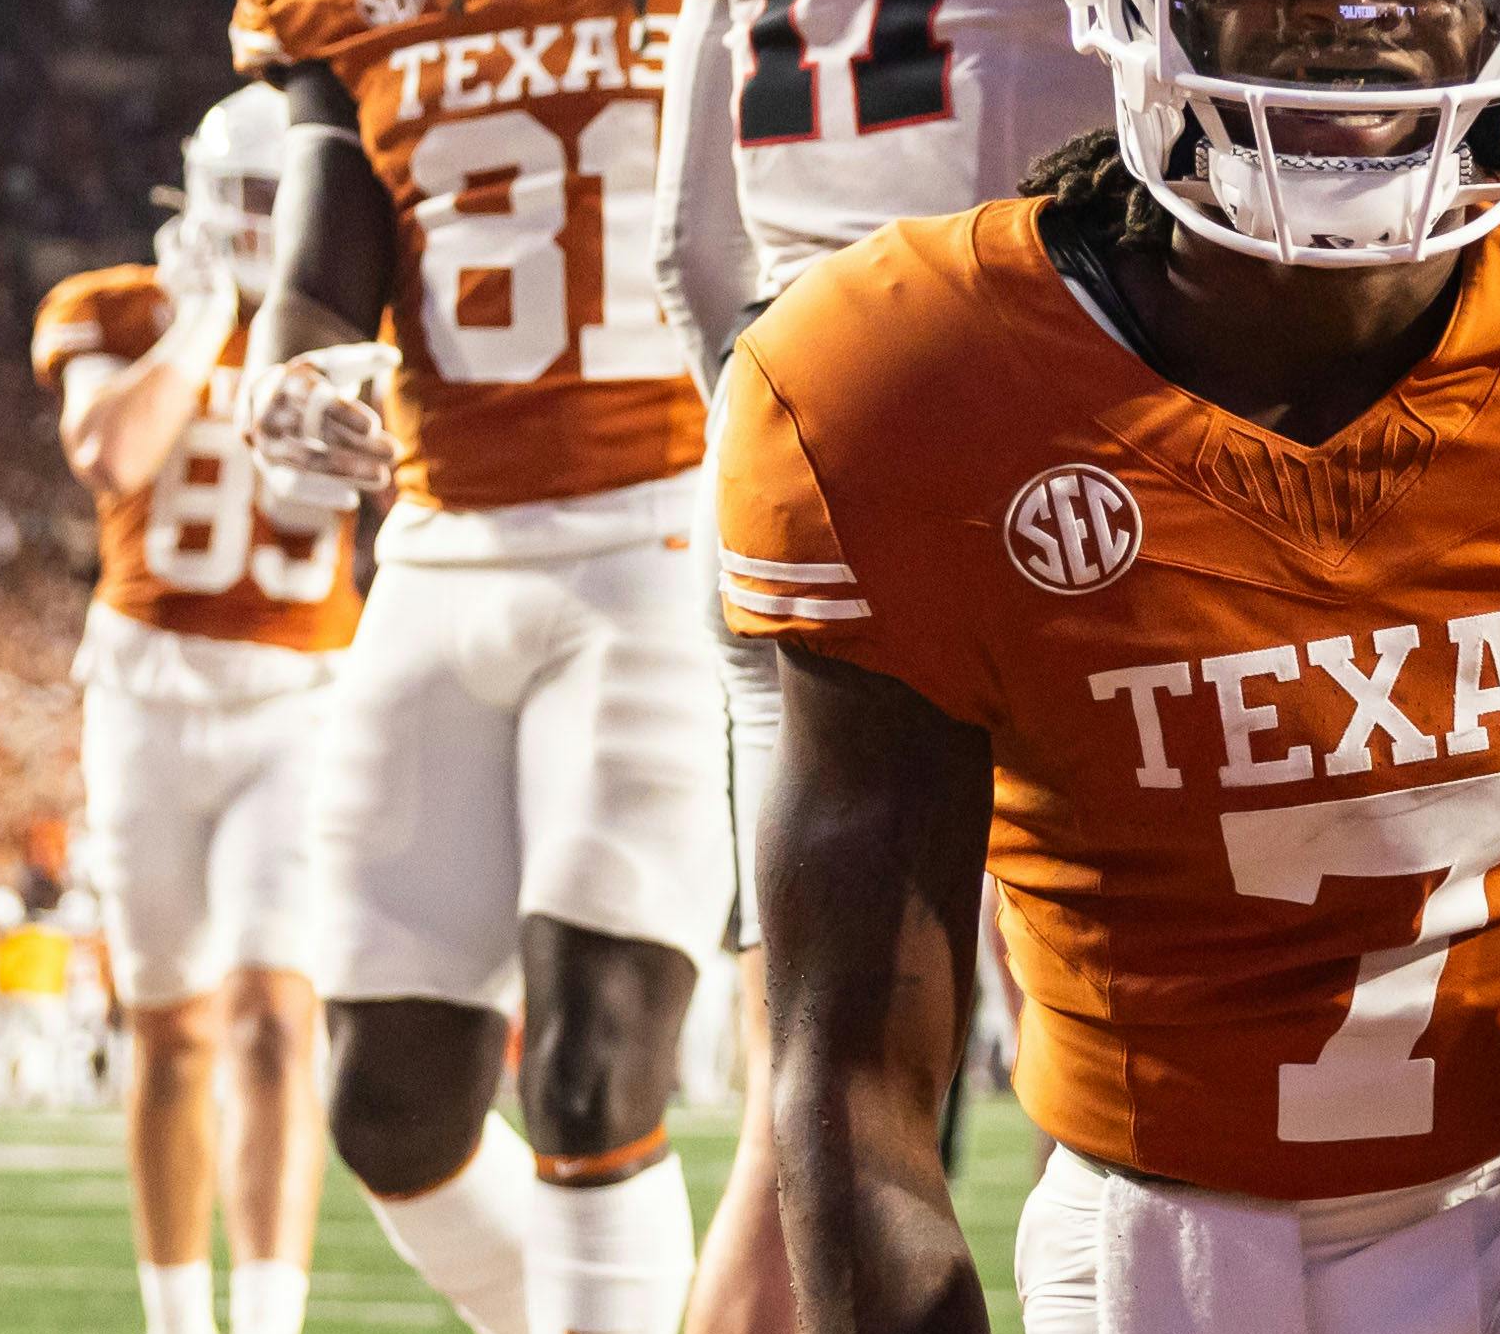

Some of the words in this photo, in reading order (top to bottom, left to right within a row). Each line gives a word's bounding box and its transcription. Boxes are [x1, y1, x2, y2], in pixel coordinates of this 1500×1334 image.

[389, 13, 678, 122] TEXAS
[408, 97, 688, 386] 81
[1015, 474, 1131, 586] SEC
